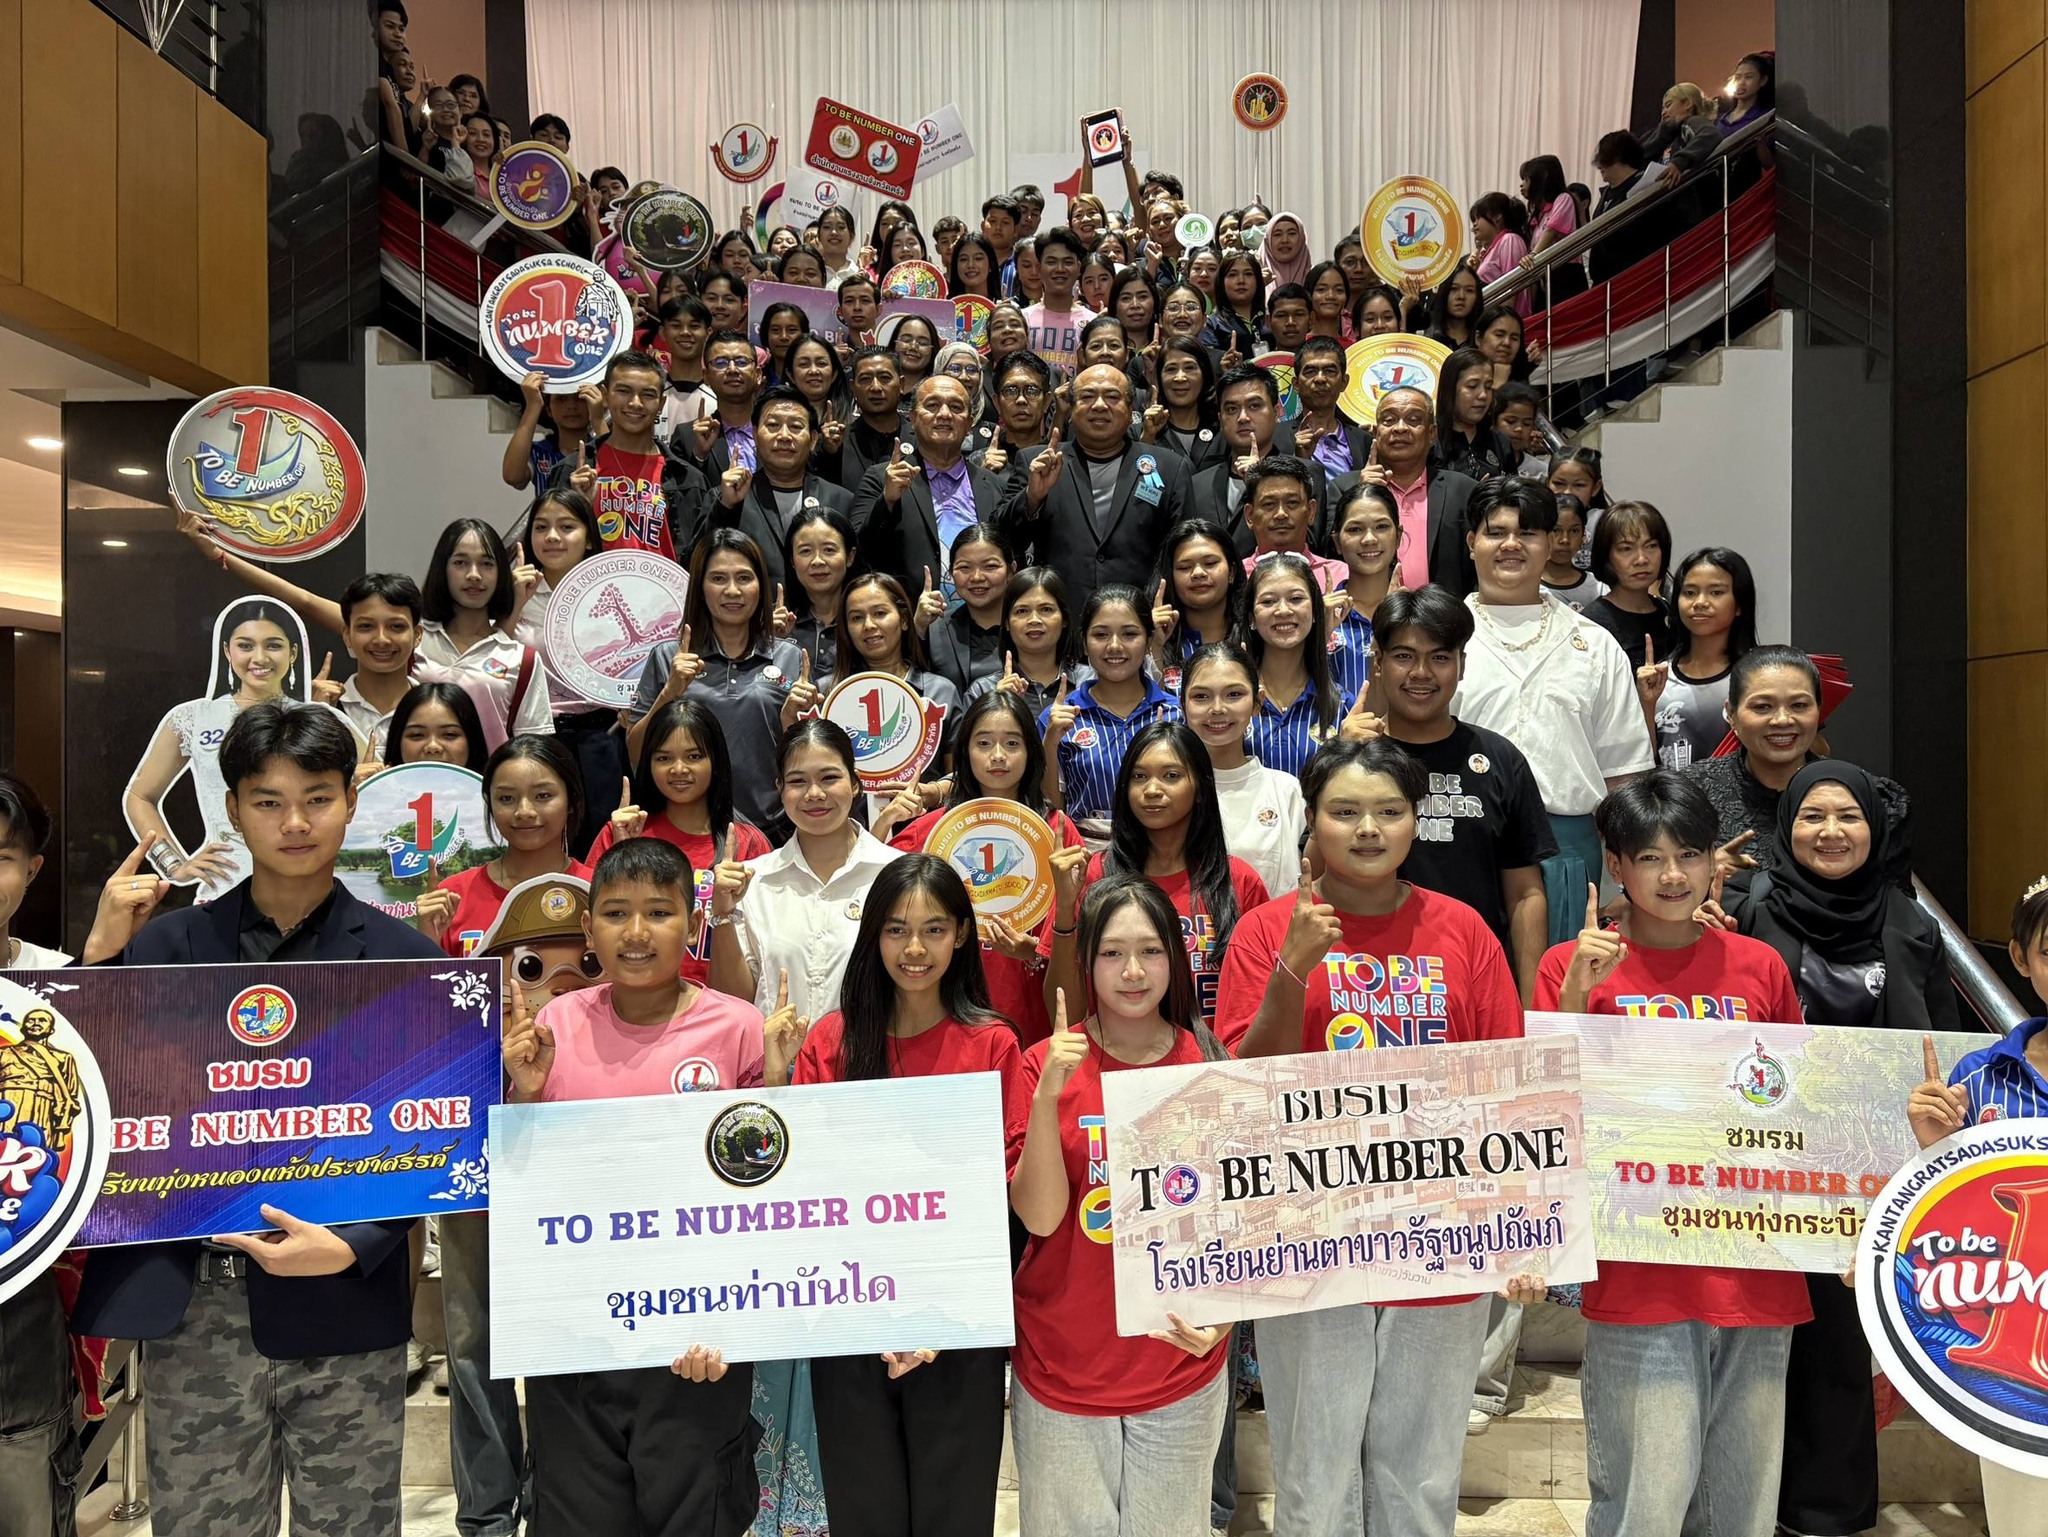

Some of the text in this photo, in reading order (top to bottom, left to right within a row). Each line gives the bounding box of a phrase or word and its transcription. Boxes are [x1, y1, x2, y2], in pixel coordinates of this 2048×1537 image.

[824, 103, 916, 147] TO BE NUMBER ONE
[737, 130, 748, 156] 1
[498, 172, 549, 220] TO BE NUMBER ONE
[1406, 186, 1436, 200] NUMBER
[1404, 212, 1416, 237] 1
[554, 258, 586, 274] SCHOOL
[501, 313, 520, 326] To
[526, 279, 577, 368] 1
[961, 303, 972, 333] 1
[1029, 326, 1057, 350] TO
[1374, 349, 1384, 357] TO
[1397, 347, 1430, 362] NUMBER
[1391, 366, 1404, 385] 1
[232, 407, 271, 477] 1
[194, 448, 225, 470] TO
[214, 470, 246, 491] BE
[245, 474, 296, 494] NUMBER
[597, 475, 635, 499] TO
[601, 498, 665, 519] NUMBER
[597, 511, 664, 548] ONE
[556, 559, 672, 624] TO BE NUMBER ONE
[859, 688, 881, 737] 1
[199, 729, 224, 745] 32
[856, 738, 874, 751] BE
[1429, 772, 1462, 794] BE
[408, 792, 433, 852] 1
[953, 820, 964, 833] TO
[964, 813, 978, 825] BE
[979, 811, 1022, 828] NUMBER
[1021, 820, 1041, 842] ONE
[1416, 817, 1454, 842] NE
[383, 835, 405, 855] TO
[400, 851, 424, 869] BE
[979, 842, 994, 874] 1
[1322, 952, 1447, 994] TO BE
[253, 994, 266, 1020] 1
[1330, 989, 1447, 1016] NUMBER
[1615, 994, 1748, 1022] TO BE
[1325, 1012, 1447, 1051] ONE
[209, 1059, 311, 1091] ชมรม
[692, 1066, 702, 1085] 1
[1281, 1083, 1411, 1125] ชมรม
[111, 1097, 471, 1153] BE NUMBER ONE
[1725, 1126, 1804, 1151] ชมรม
[1219, 1154, 1277, 1202] BE
[1286, 1136, 1471, 1195] NUMBER
[1478, 1126, 1568, 1176] ONE
[1615, 1161, 1656, 1184] TO
[1667, 1163, 1705, 1187] BE
[1716, 1166, 1849, 1196] NUMBER
[1872, 1135, 2048, 1253] KANTANGRATSADASUKS
[538, 1191, 947, 1246] TO BE NUMBER ONE
[1146, 1201, 1564, 1294] โรงเรียนย่านตาขาวรัฐชนูปถัมภ์
[1912, 1227, 1997, 1262] To be
[606, 1261, 897, 1332] ชุมชนท่าบันได
